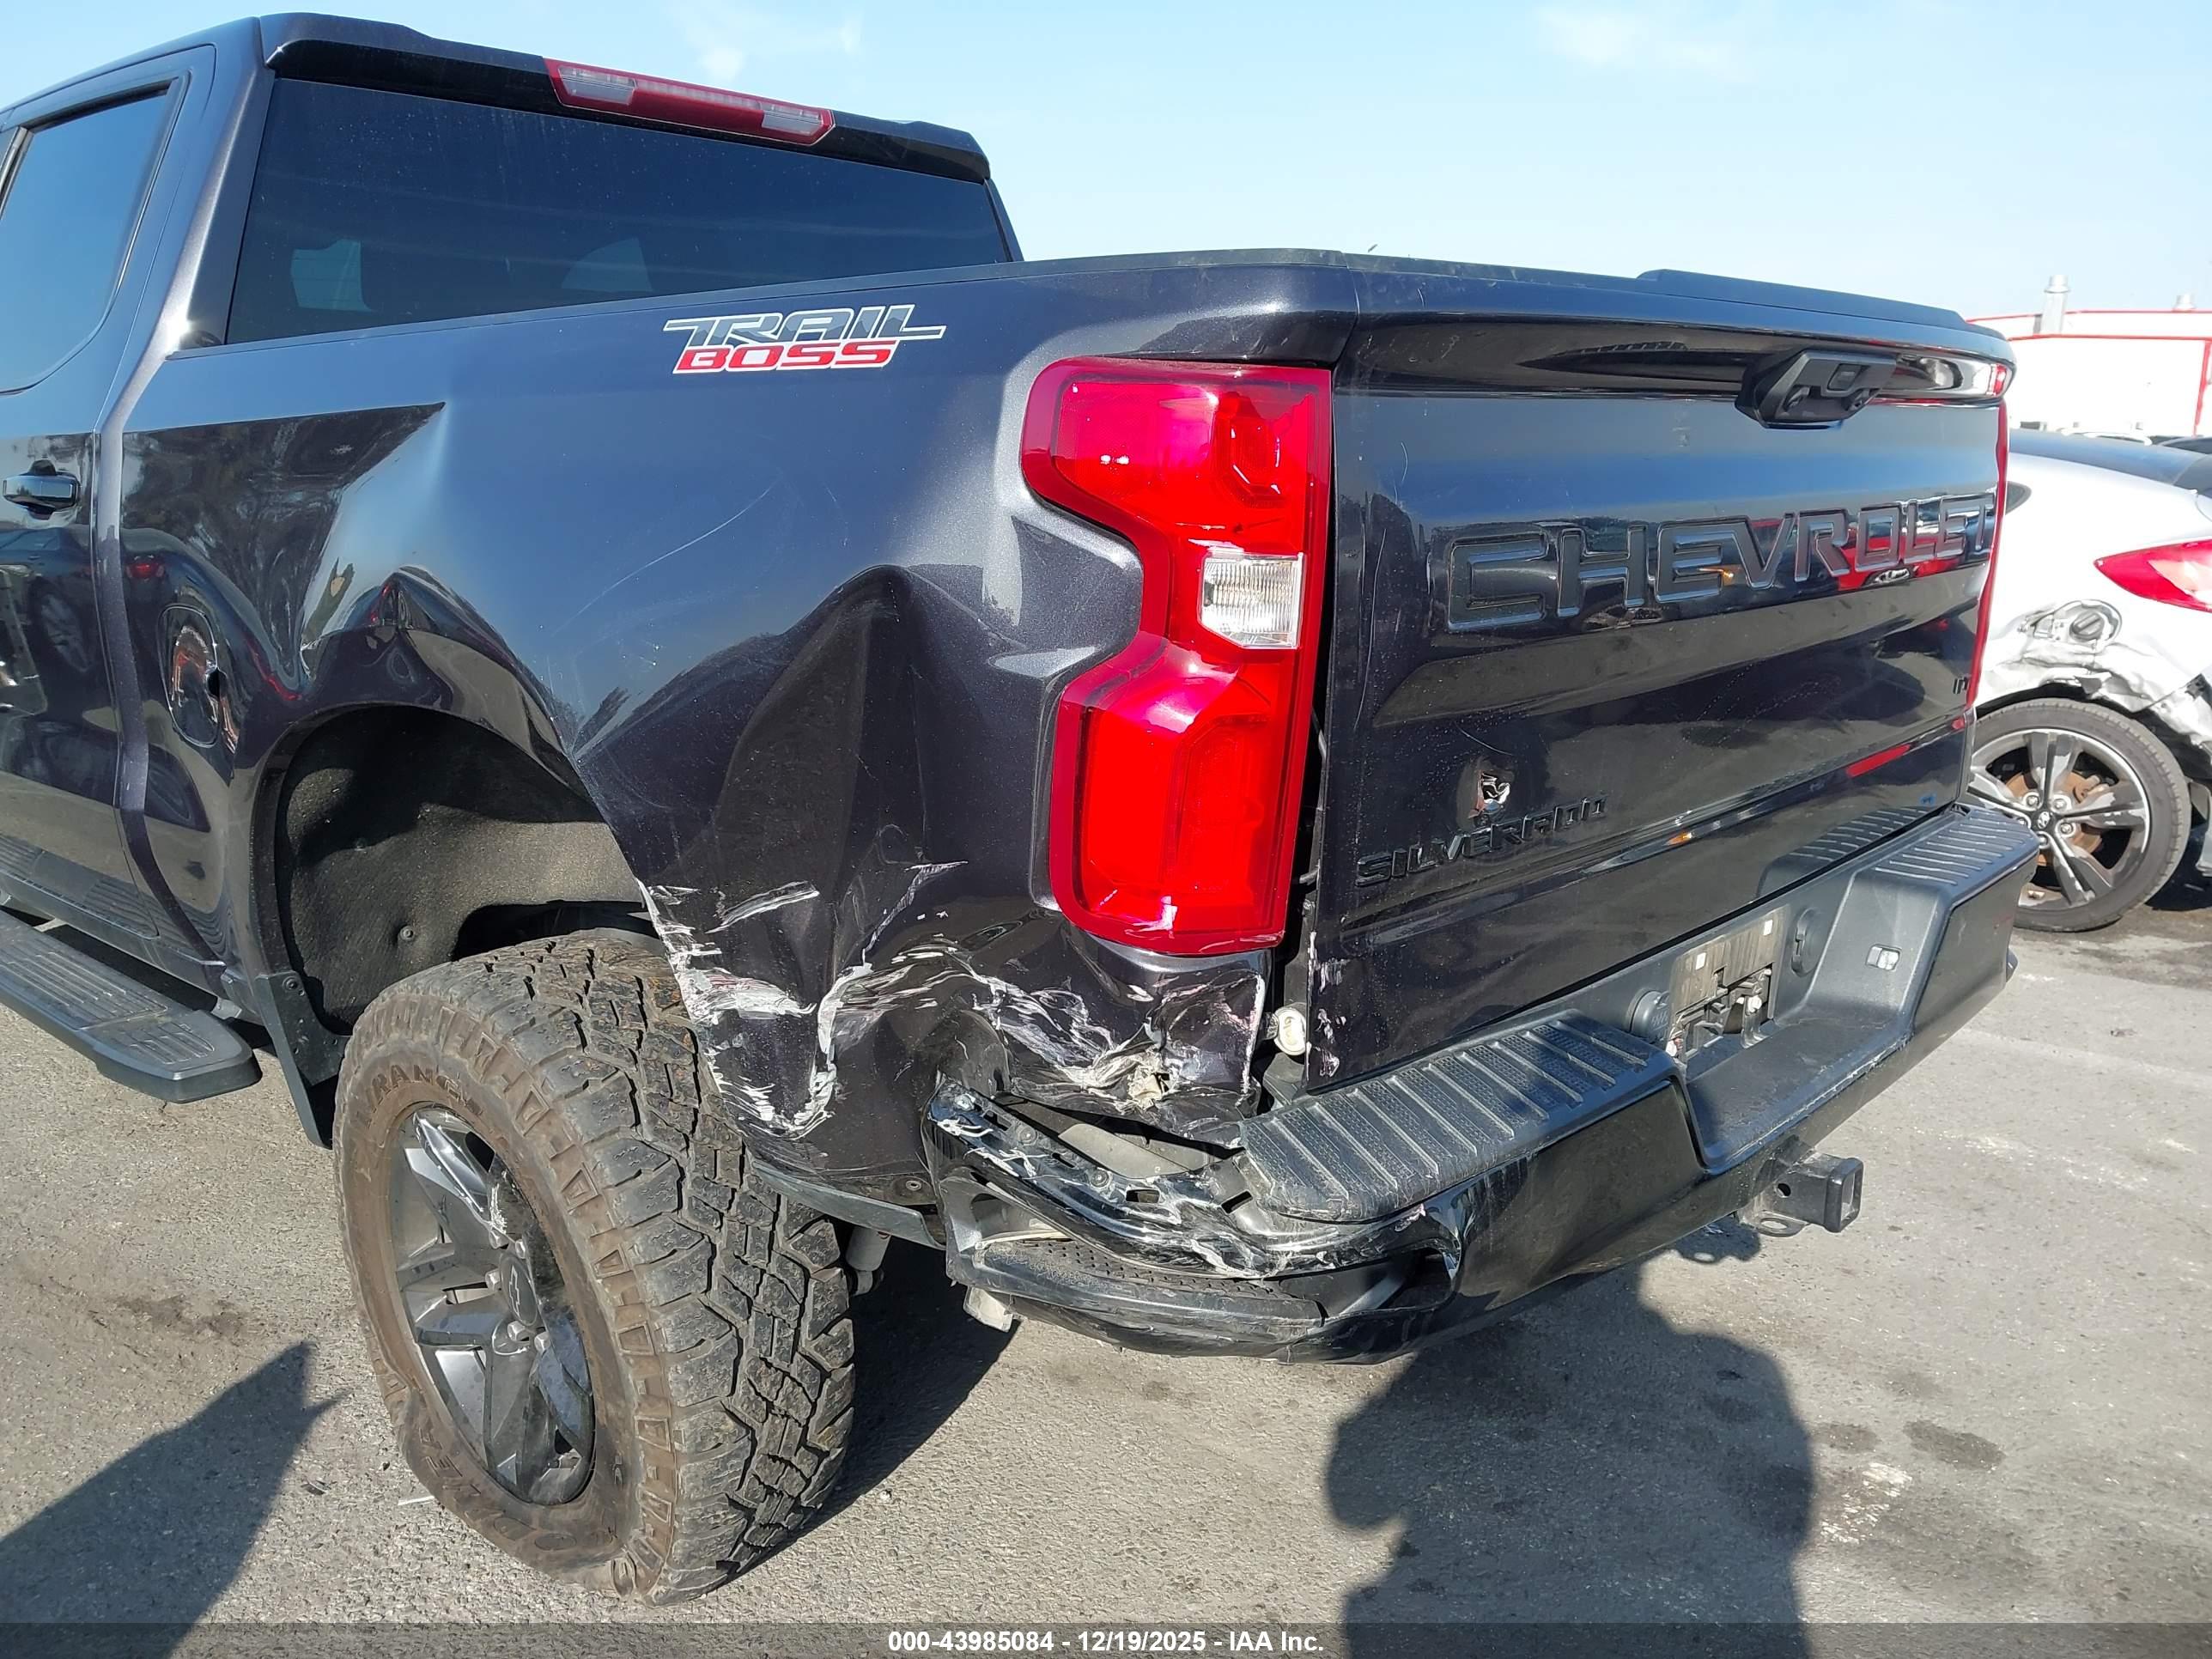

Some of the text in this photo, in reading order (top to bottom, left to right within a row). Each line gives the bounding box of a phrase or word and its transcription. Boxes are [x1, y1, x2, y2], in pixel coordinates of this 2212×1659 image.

[663, 304, 947, 348] TRAIL
[672, 338, 901, 374] BOSS
[1446, 491, 1995, 633] CHEVROLET
[1354, 795, 1607, 888] SILVERADO
